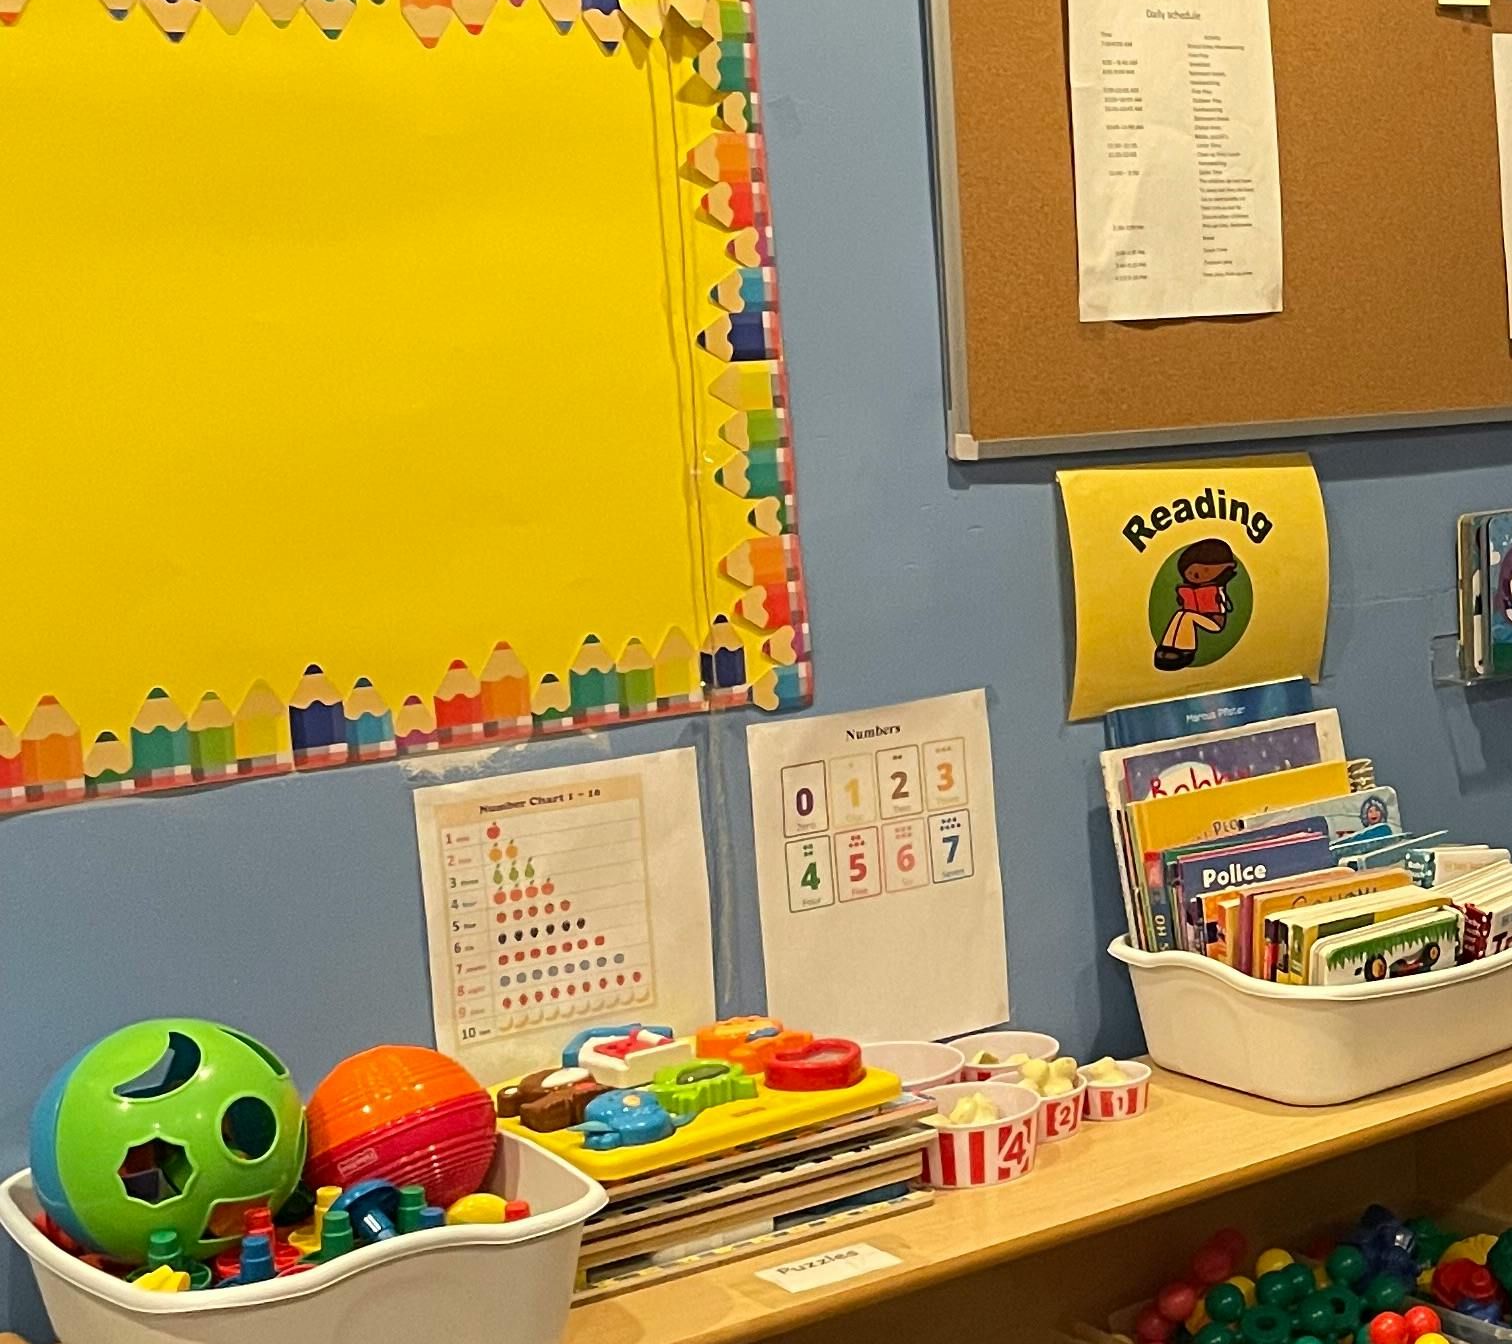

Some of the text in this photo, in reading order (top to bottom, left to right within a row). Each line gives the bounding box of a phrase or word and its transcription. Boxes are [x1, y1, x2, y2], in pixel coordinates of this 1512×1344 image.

[1122, 488, 1274, 553] Reading
[845, 724, 901, 742] Numbers
[796, 762, 955, 817] 0 1 2 3
[479, 799, 527, 814] Number
[529, 794, 564, 806] Chart
[800, 835, 960, 891] 4 5 6 7
[449, 877, 457, 888] 3
[1203, 862, 1267, 887] Police
[452, 921, 460, 932] 5
[454, 942, 461, 953] 6
[462, 1027, 476, 1040] 10
[1116, 1096, 1124, 1111] 1
[1059, 1105, 1071, 1126] 2
[1003, 1132, 1027, 1164] 4
[776, 1250, 859, 1275] Puzzles
